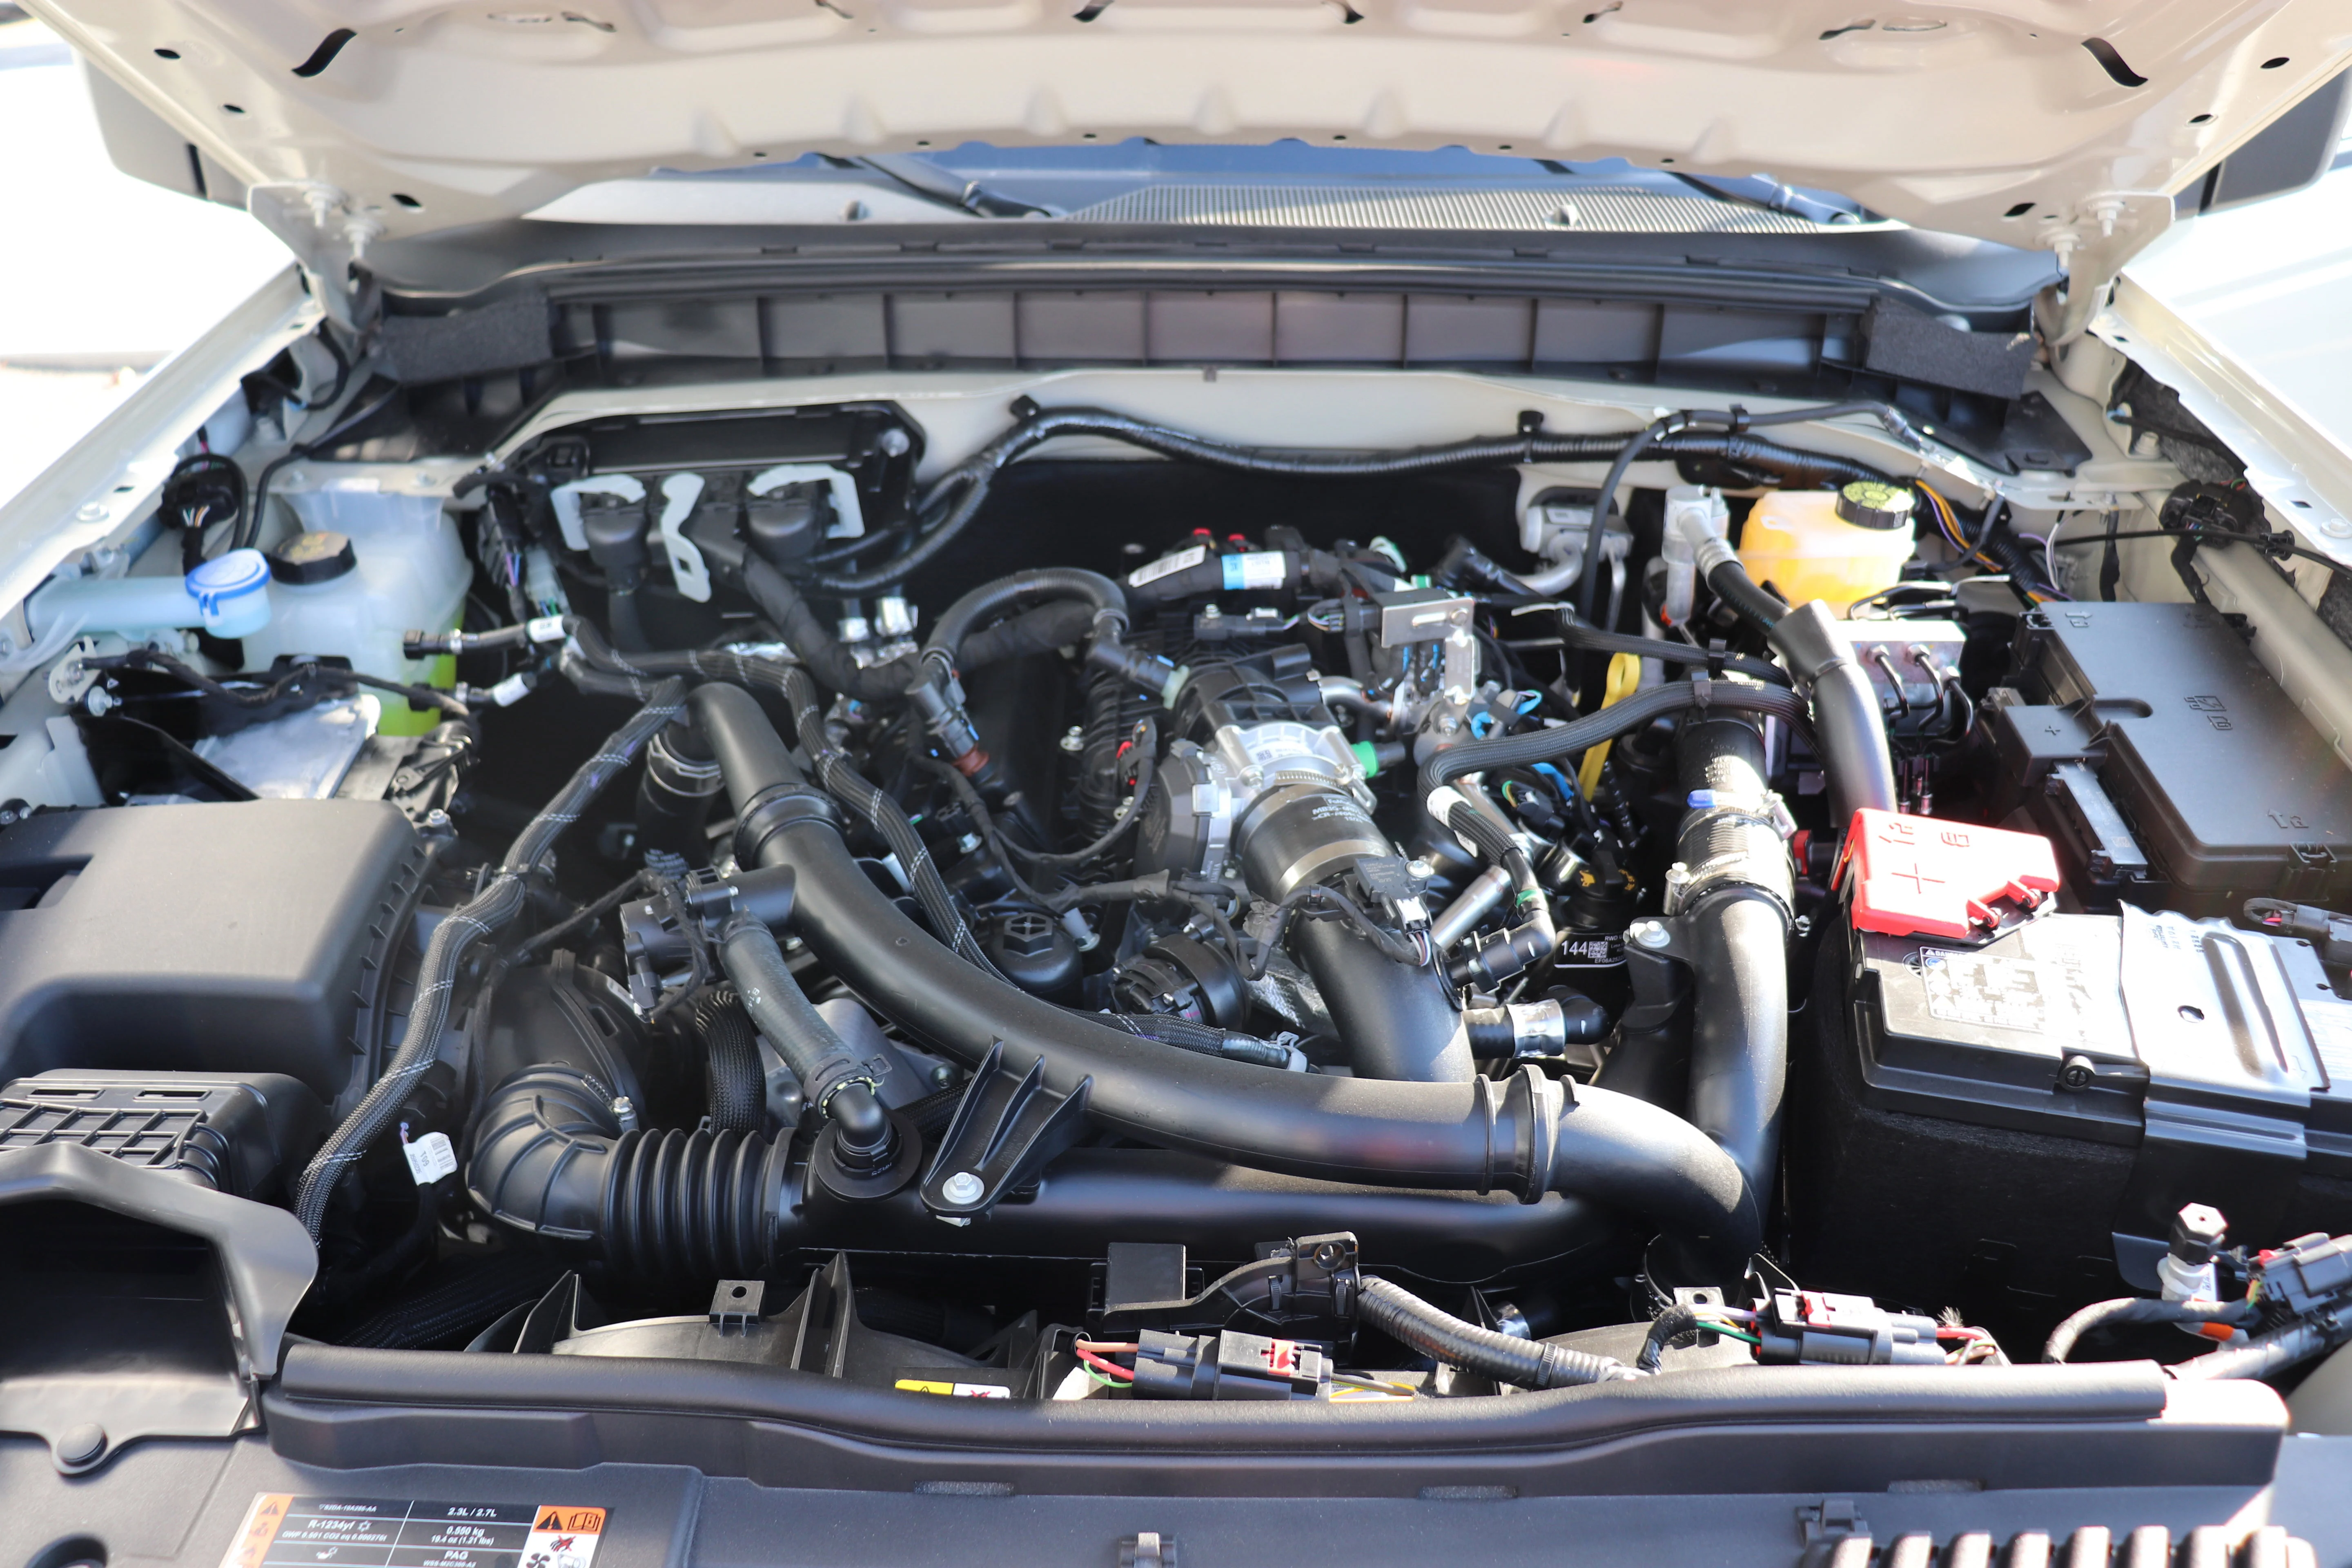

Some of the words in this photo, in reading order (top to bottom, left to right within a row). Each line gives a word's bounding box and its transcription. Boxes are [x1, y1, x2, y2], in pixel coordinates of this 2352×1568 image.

[1561, 940, 1588, 956] 144
[421, 1149, 429, 1167] T09
[448, 1507, 468, 1516] 2.3L
[475, 1508, 497, 1517] 2.7L
[307, 1519, 355, 1530] R-1234yf
[472, 1526, 485, 1537] kg
[432, 1535, 447, 1544] 19.4
[459, 1536, 477, 1545] (1.21
[479, 1537, 494, 1546] lbs)
[444, 1550, 469, 1560] PAG
